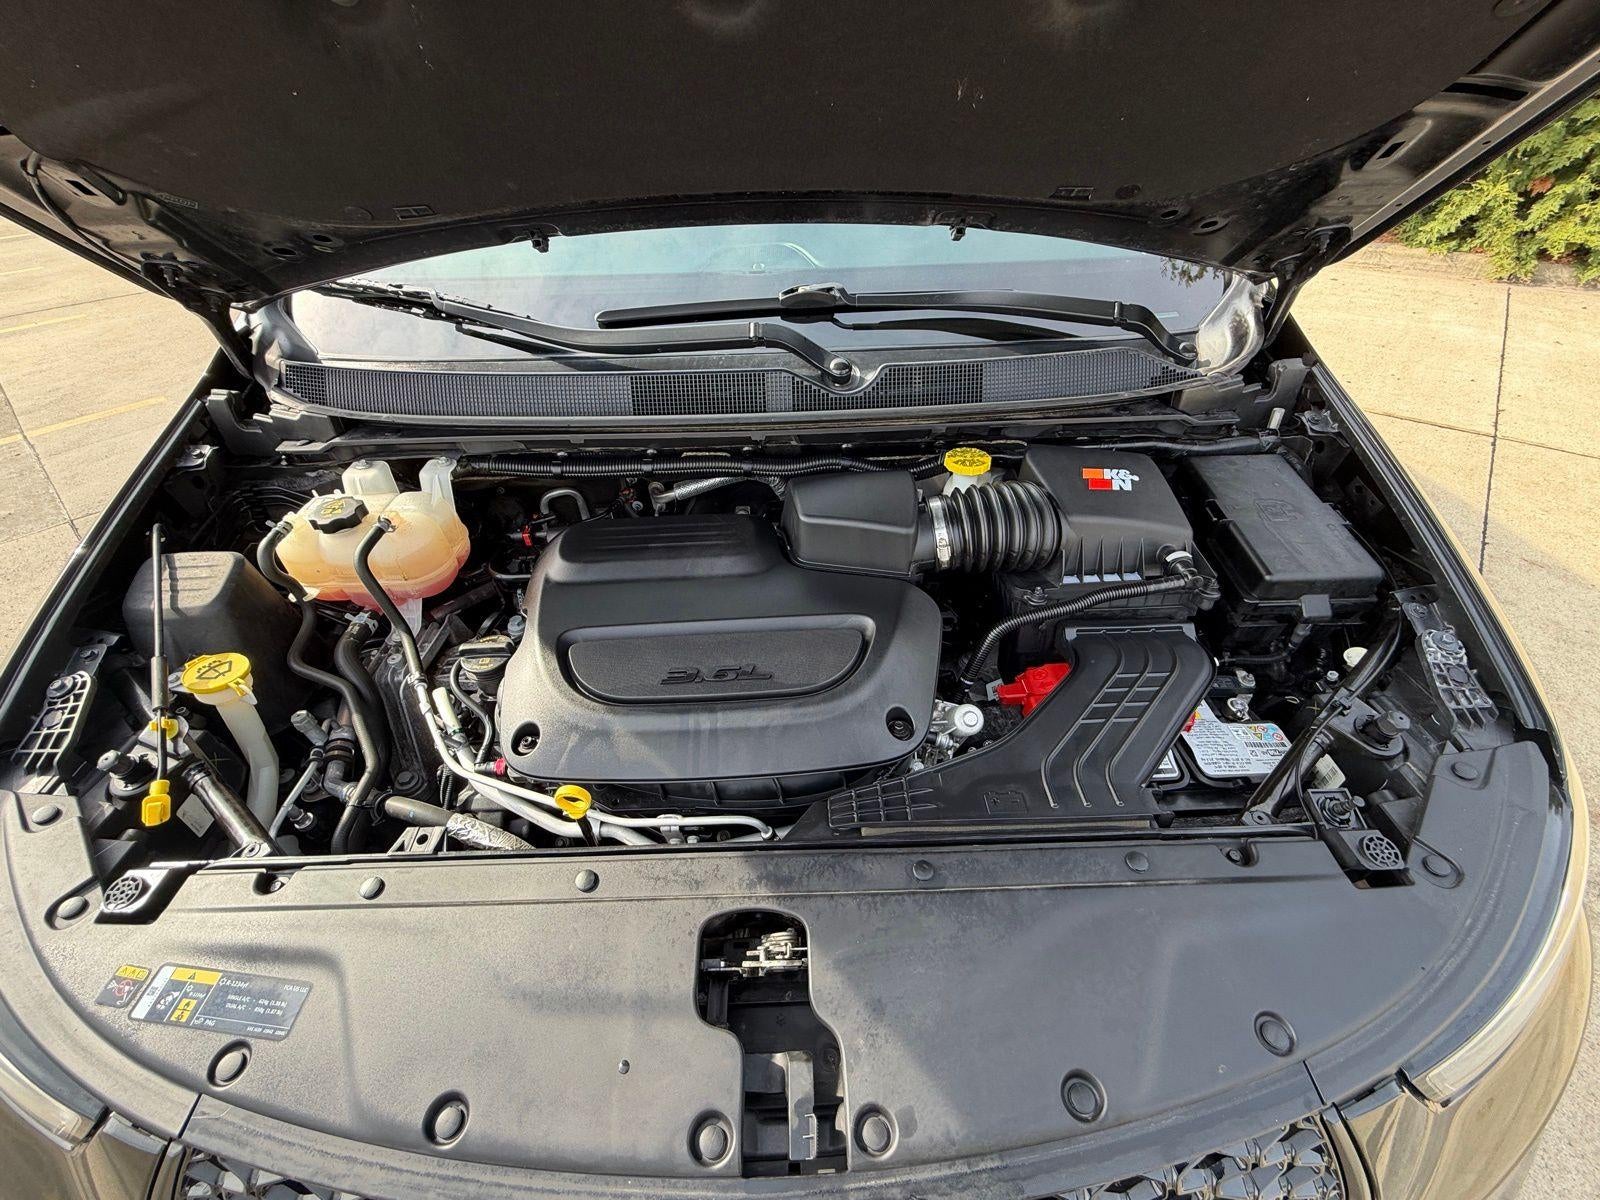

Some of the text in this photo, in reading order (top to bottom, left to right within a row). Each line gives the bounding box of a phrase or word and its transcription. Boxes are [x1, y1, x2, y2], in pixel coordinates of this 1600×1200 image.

[1103, 468, 1140, 491] K&N
[660, 662, 773, 685] 3.6L
[204, 1018, 216, 1026] PAG
